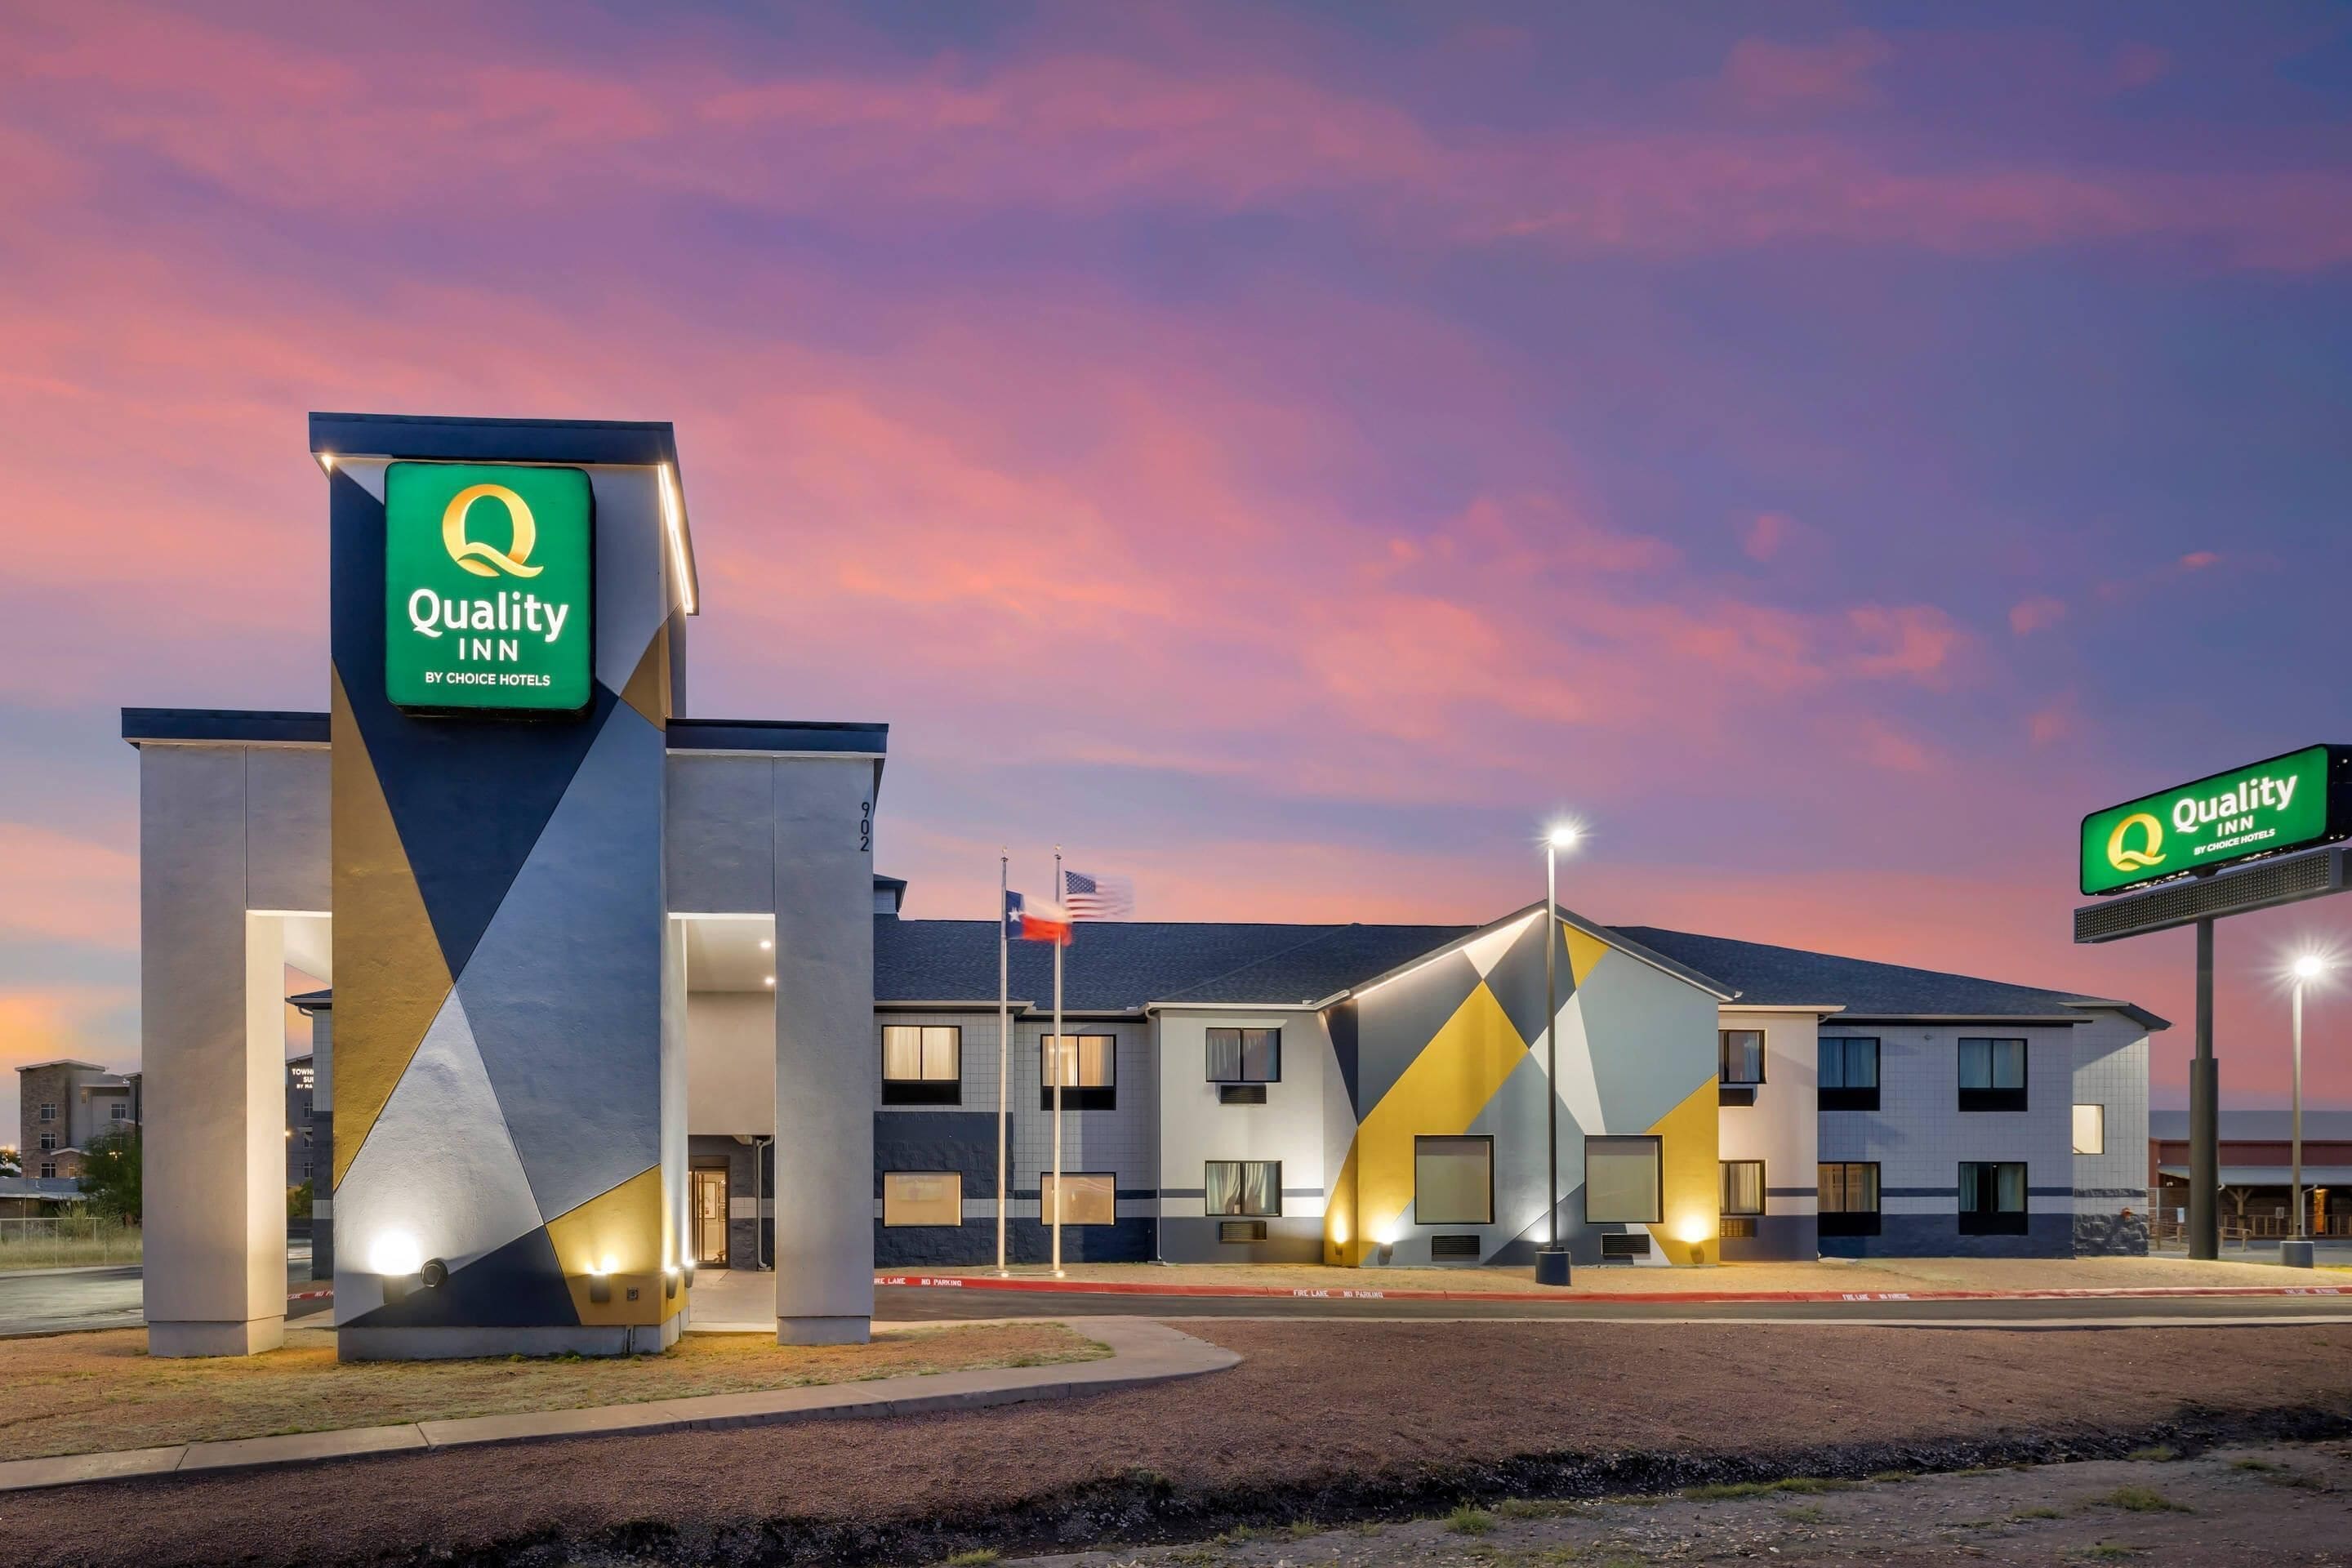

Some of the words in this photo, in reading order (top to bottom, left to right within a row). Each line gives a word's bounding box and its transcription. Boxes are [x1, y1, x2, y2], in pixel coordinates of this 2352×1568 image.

[442, 483, 544, 577] Q
[409, 588, 569, 642] Quality
[459, 638, 519, 662] INN
[425, 671, 443, 684] BY
[446, 672, 497, 685] CHOICE
[499, 674, 551, 687] HOTELS
[2172, 775, 2298, 833] Quality
[860, 802, 870, 852] 902
[2108, 813, 2167, 871] Q
[2194, 844, 2206, 856] BY
[2207, 837, 2240, 852] CHOICE
[2240, 828, 2276, 844] HOTELS
[2217, 815, 2254, 837] INN
[888, 1277, 906, 1285] LANE
[920, 1278, 931, 1286] NO
[933, 1279, 962, 1287] PARKING
